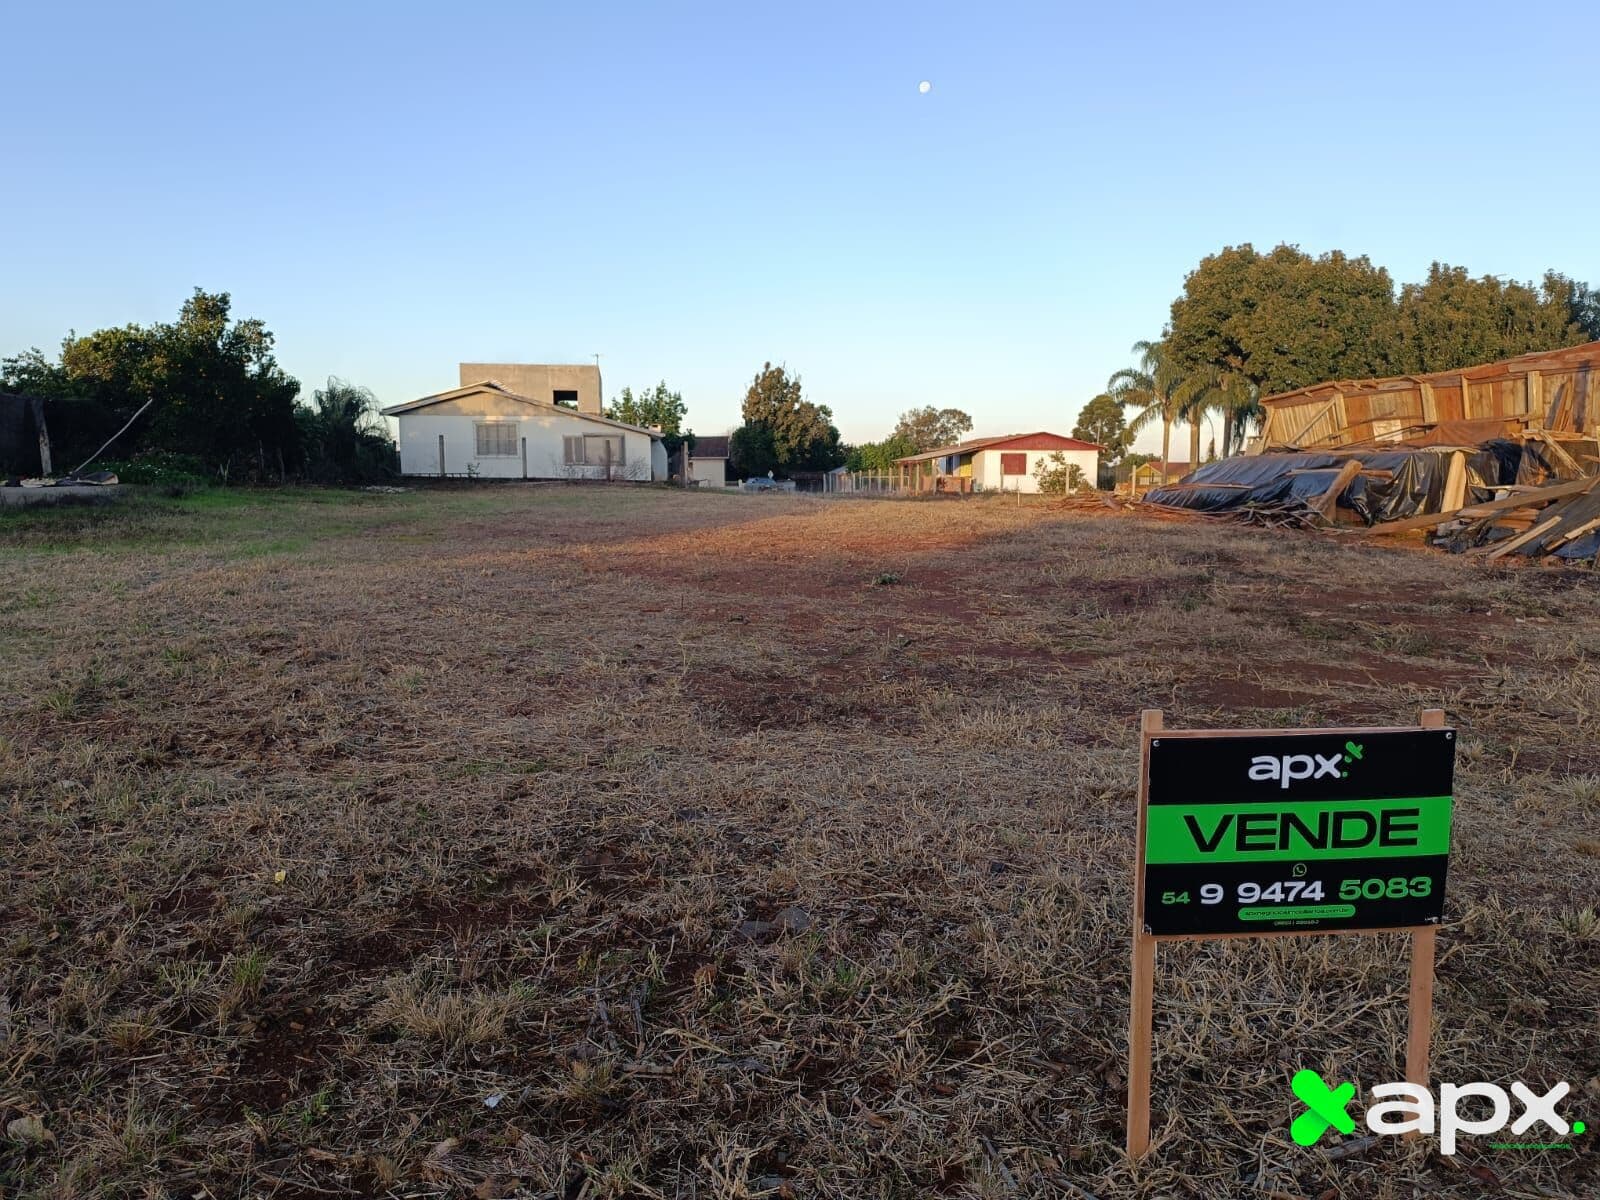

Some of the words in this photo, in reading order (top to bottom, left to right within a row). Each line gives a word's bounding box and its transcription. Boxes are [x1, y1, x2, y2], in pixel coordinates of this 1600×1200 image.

[1183, 807, 1420, 853] VENDE
[1161, 891, 1191, 905] 54
[1200, 883, 1225, 905] 9
[1236, 880, 1326, 905] 9474
[1338, 876, 1433, 901] 5083
